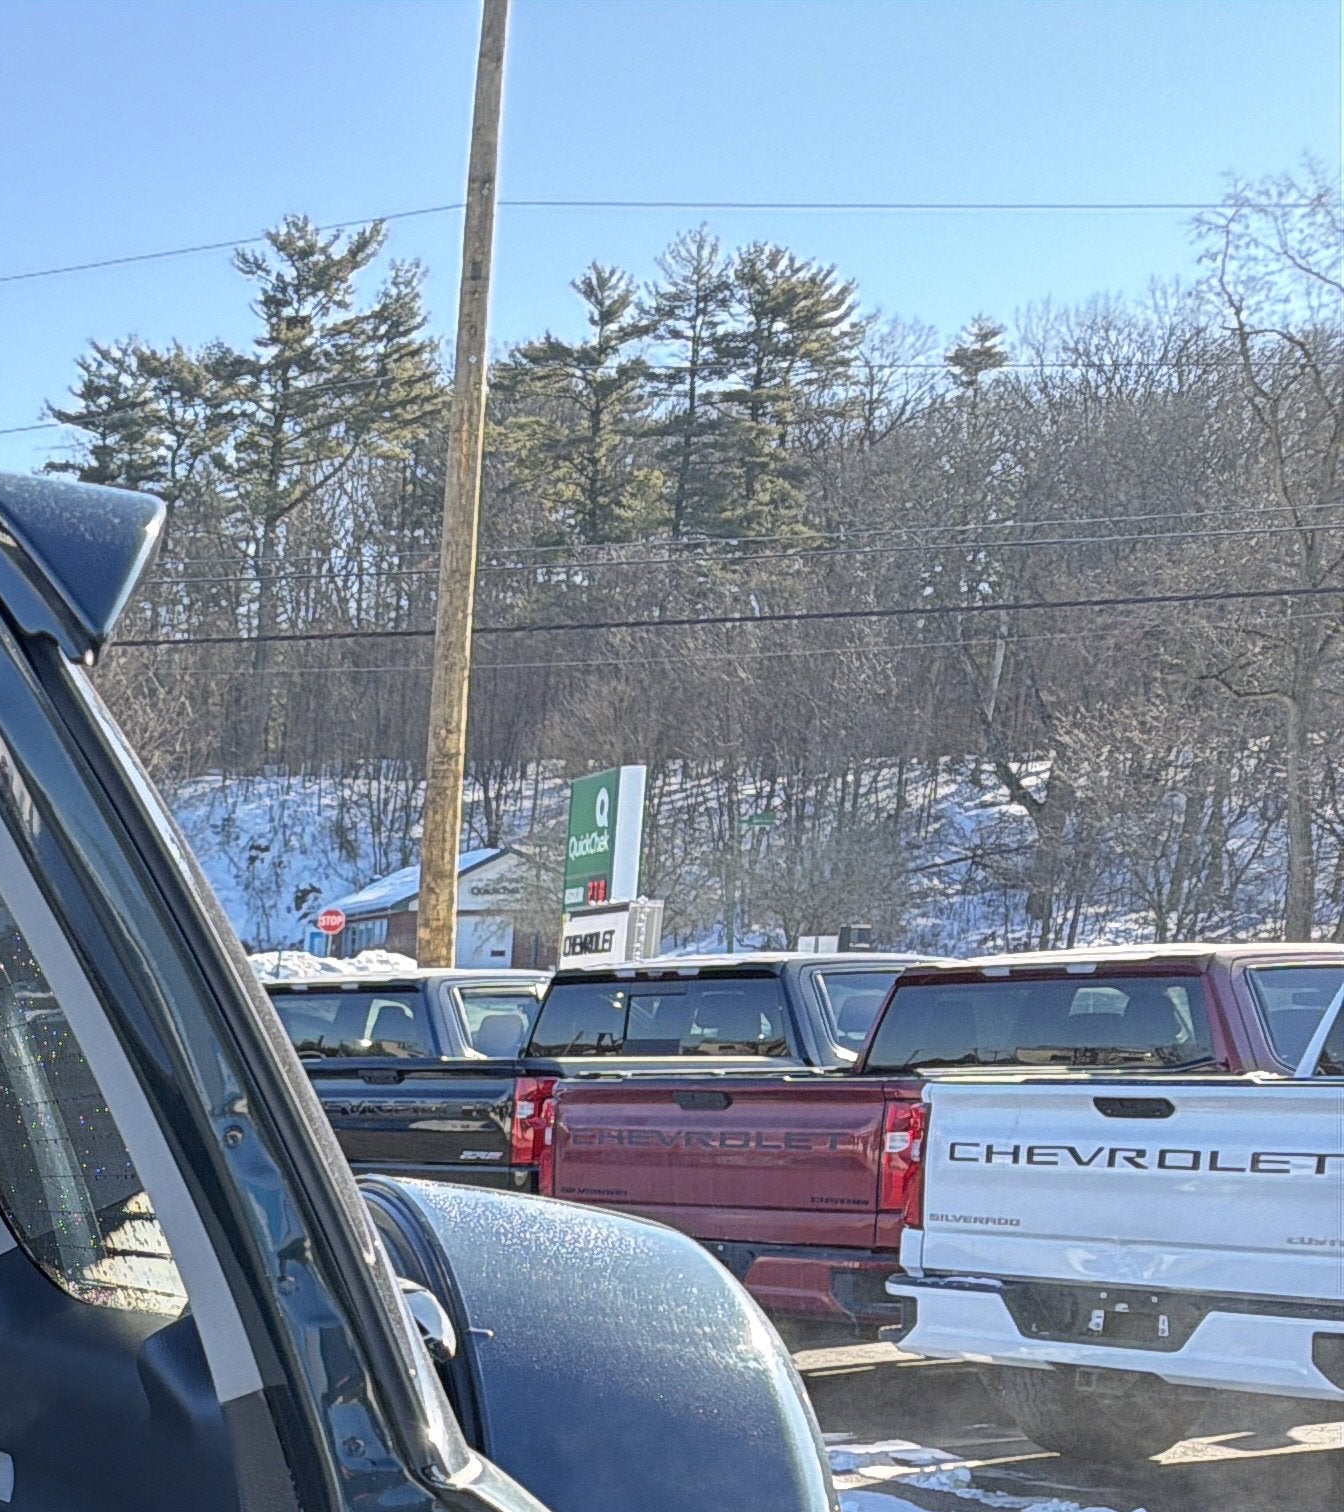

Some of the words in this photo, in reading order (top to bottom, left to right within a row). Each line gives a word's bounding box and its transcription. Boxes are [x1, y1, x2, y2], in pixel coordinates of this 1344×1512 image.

[568, 829, 610, 861] QuickChek
[319, 914, 344, 927] STOP
[571, 1127, 851, 1151] CHEVROLET
[948, 1142, 1344, 1175] CHEVROLET
[928, 1213, 1021, 1227] SILVERADO
